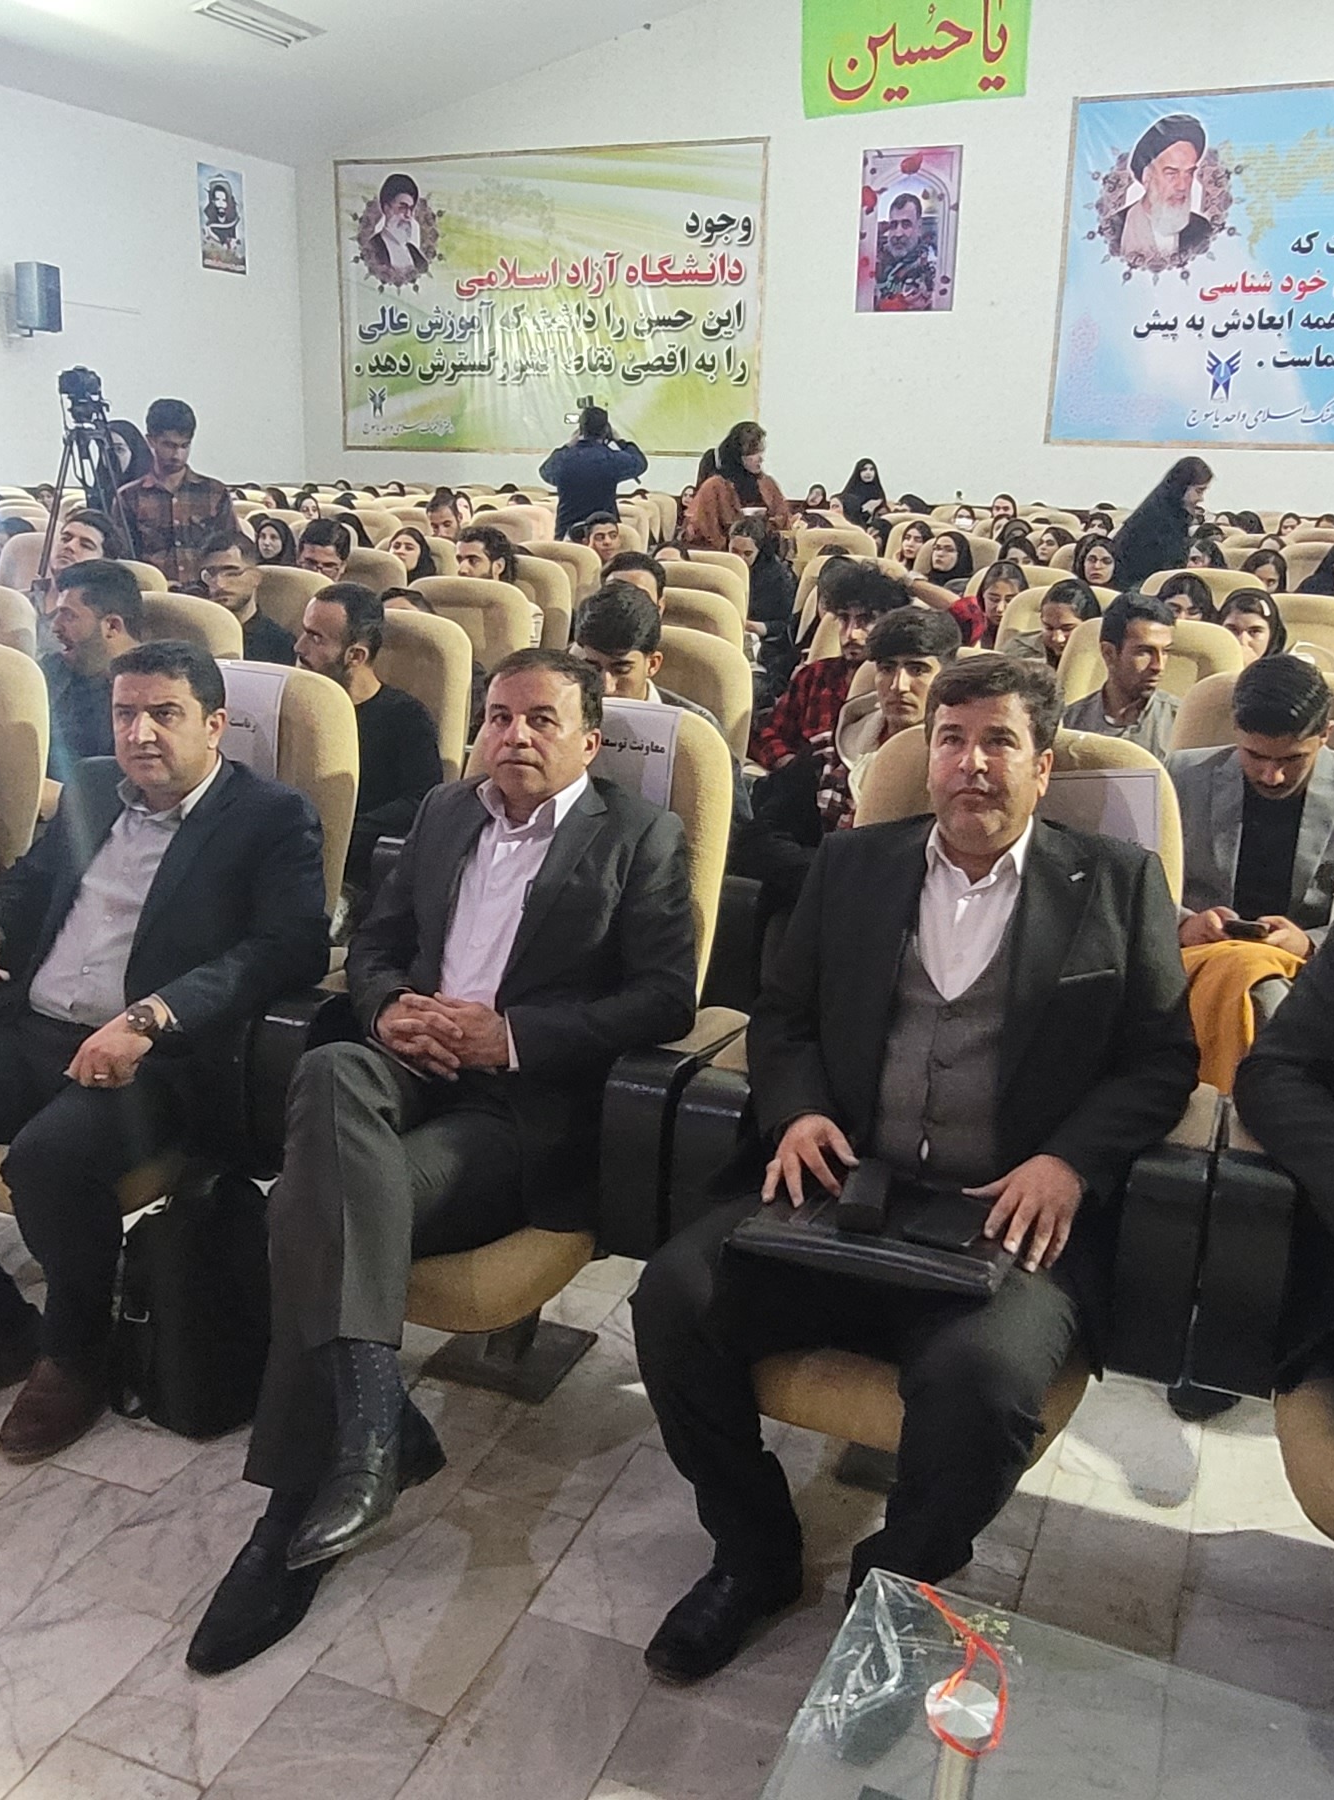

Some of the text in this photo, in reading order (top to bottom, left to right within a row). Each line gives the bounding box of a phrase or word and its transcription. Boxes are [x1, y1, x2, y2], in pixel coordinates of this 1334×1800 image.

[684, 209, 754, 246] وجود
[1290, 230, 1320, 255] که
[454, 250, 746, 300] دانشگاه آزاد اسلامی
[357, 305, 410, 342] عالی
[416, 299, 495, 343] آموزش
[603, 301, 628, 341] را
[632, 307, 695, 337] حسن
[701, 299, 745, 340] این
[1131, 308, 1179, 341] پیش
[1184, 312, 1205, 338] به
[1210, 306, 1294, 338] ابعادش
[367, 351, 413, 375] دهد
[418, 346, 496, 385] گسترش
[694, 350, 719, 384] به
[723, 344, 749, 385] را
[1221, 407, 1248, 424] واحد
[1245, 403, 1308, 430] اسلامی
[628, 739, 666, 756] معاونت
